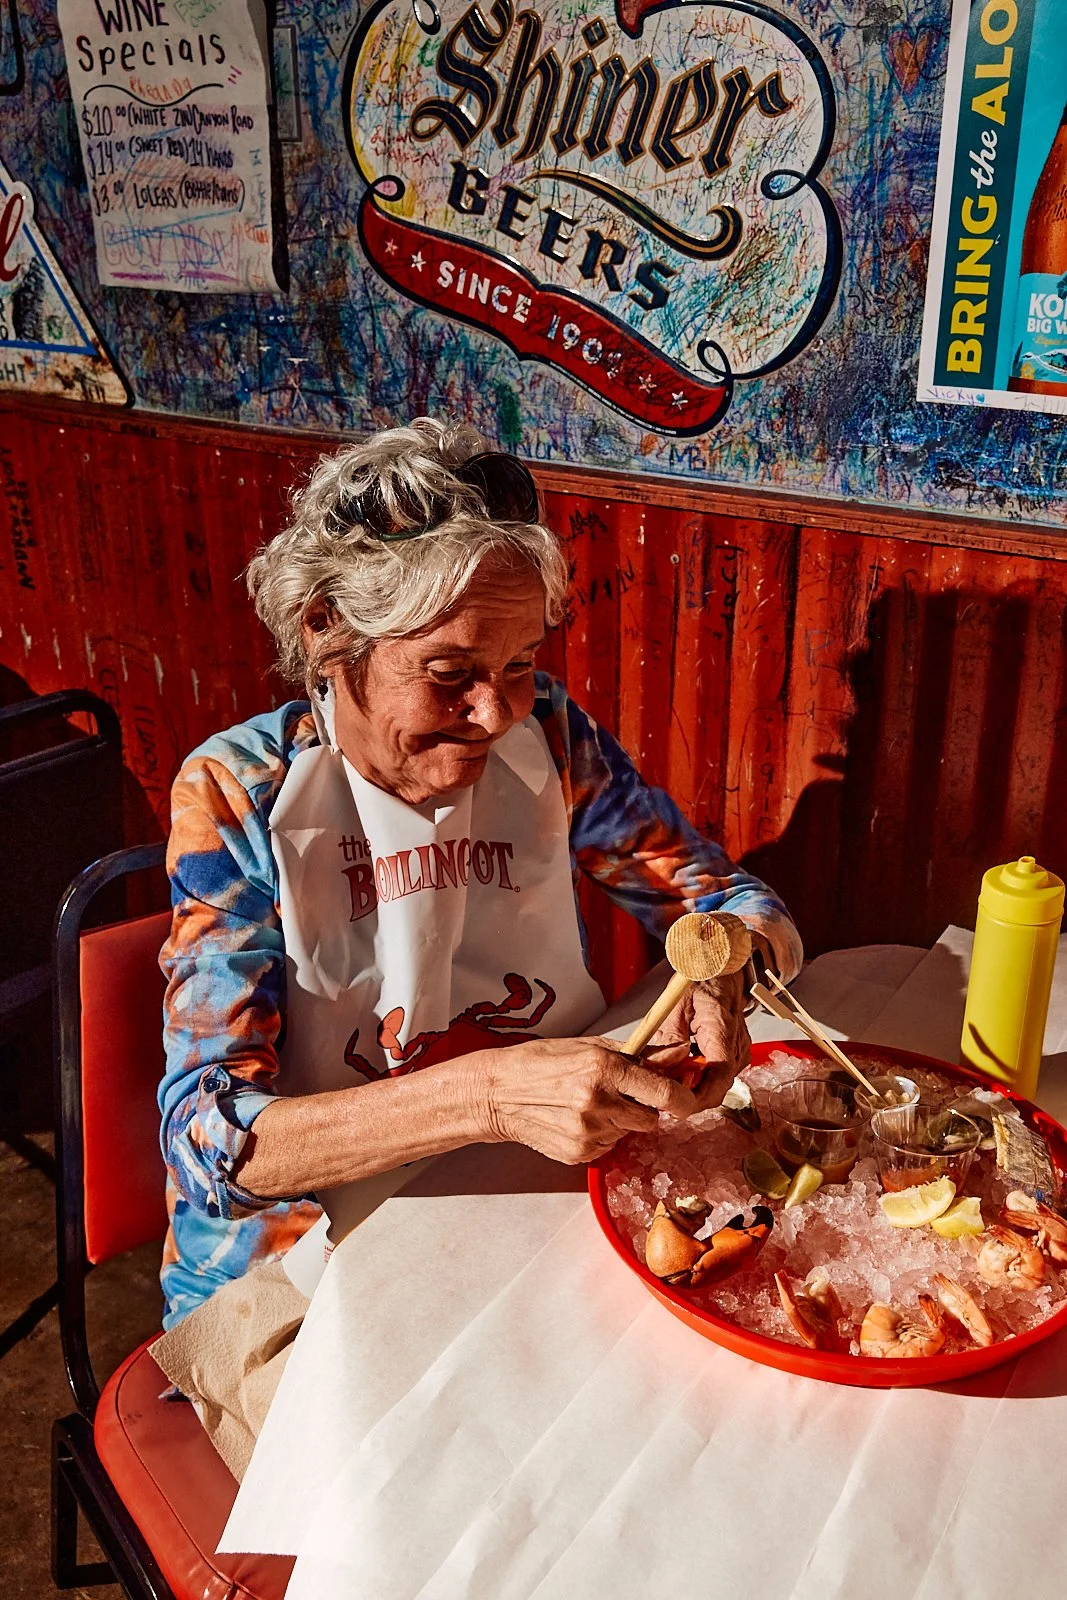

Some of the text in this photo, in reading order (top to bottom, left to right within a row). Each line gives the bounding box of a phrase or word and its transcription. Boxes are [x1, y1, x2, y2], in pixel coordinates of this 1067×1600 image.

[95, 0, 169, 36] WINE
[76, 34, 226, 75] Specials
[411, 0, 794, 177] Shiner
[969, 129, 998, 190] the
[447, 159, 680, 311] BEERS
[437, 260, 533, 324] SINCE
[946, 194, 999, 375] BRING
[1028, 292, 1067, 320] KO
[1026, 317, 1052, 335] BIG
[338, 835, 372, 862] the
[472, 839, 514, 891] OT
